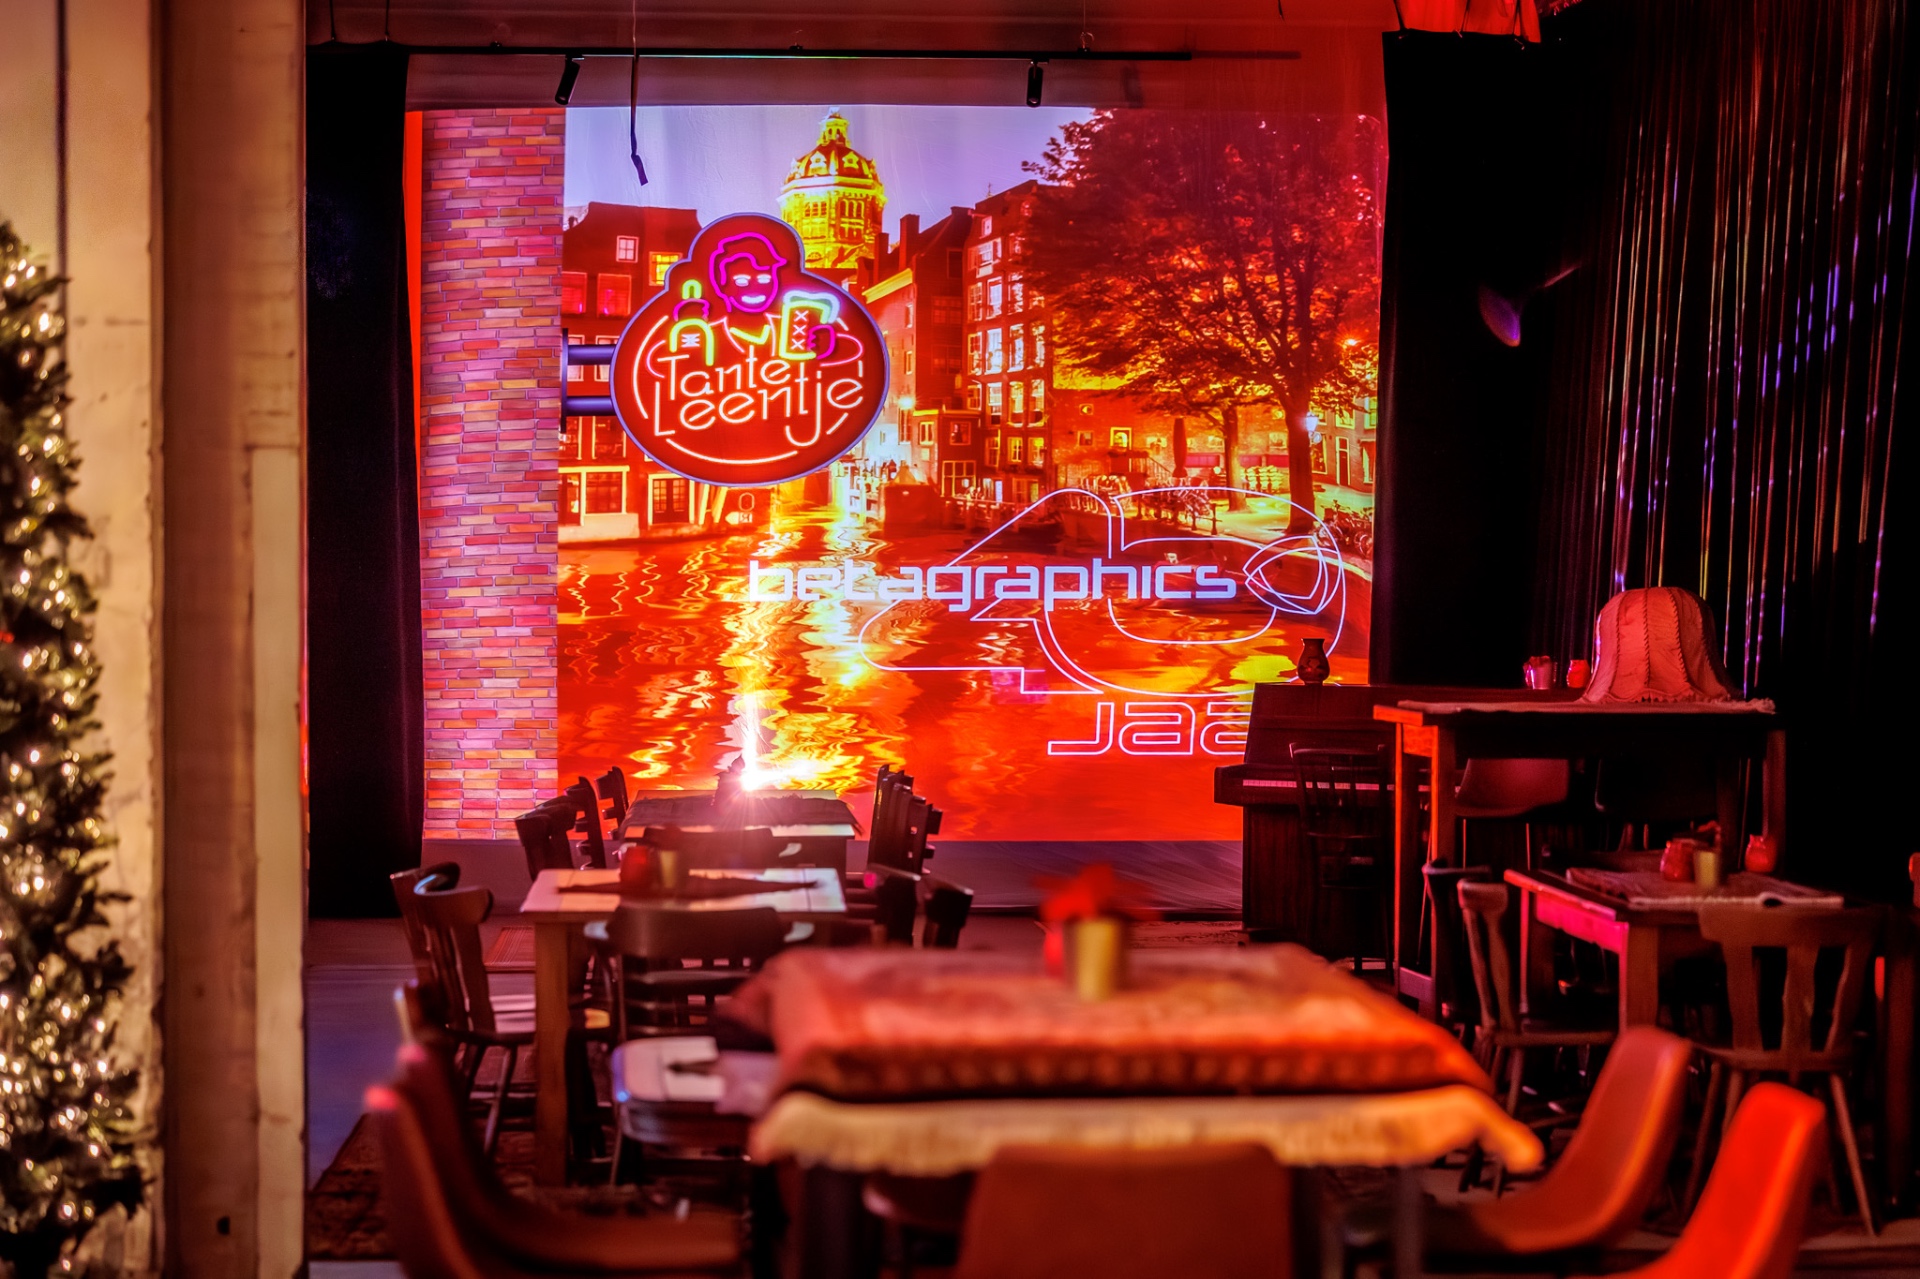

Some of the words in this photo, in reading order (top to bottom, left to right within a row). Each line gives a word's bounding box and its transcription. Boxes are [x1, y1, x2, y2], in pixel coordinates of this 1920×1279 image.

[656, 345, 792, 400] Tante
[654, 362, 864, 447] Leentje
[749, 558, 1237, 611] betagraphics
